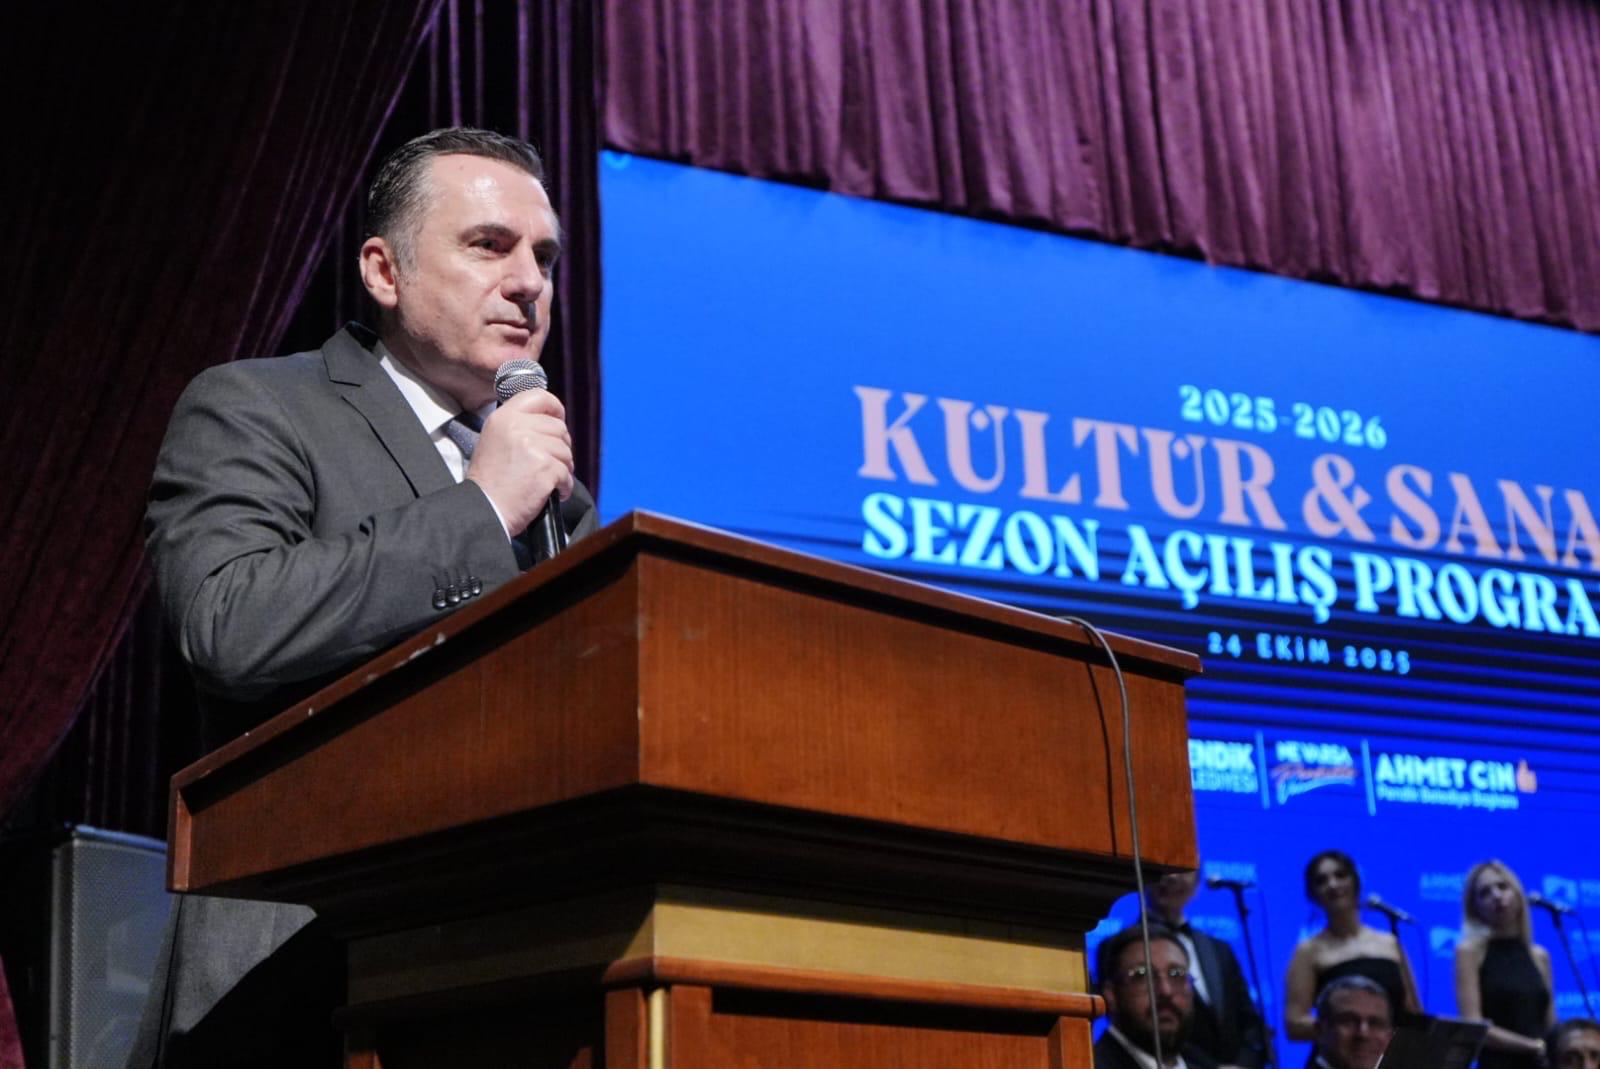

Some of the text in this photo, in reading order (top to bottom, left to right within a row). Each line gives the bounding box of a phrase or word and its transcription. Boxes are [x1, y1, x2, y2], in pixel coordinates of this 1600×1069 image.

[1180, 384, 1387, 449] 2025-2026
[854, 385, 1286, 532] KÜLTÜR
[1301, 454, 1376, 543] &
[862, 492, 1600, 638] SEZON AÇILIŞ PROGRA
[1207, 631, 1243, 658] 24
[1343, 645, 1411, 675] 2025
[1376, 753, 1466, 788] AHMET
